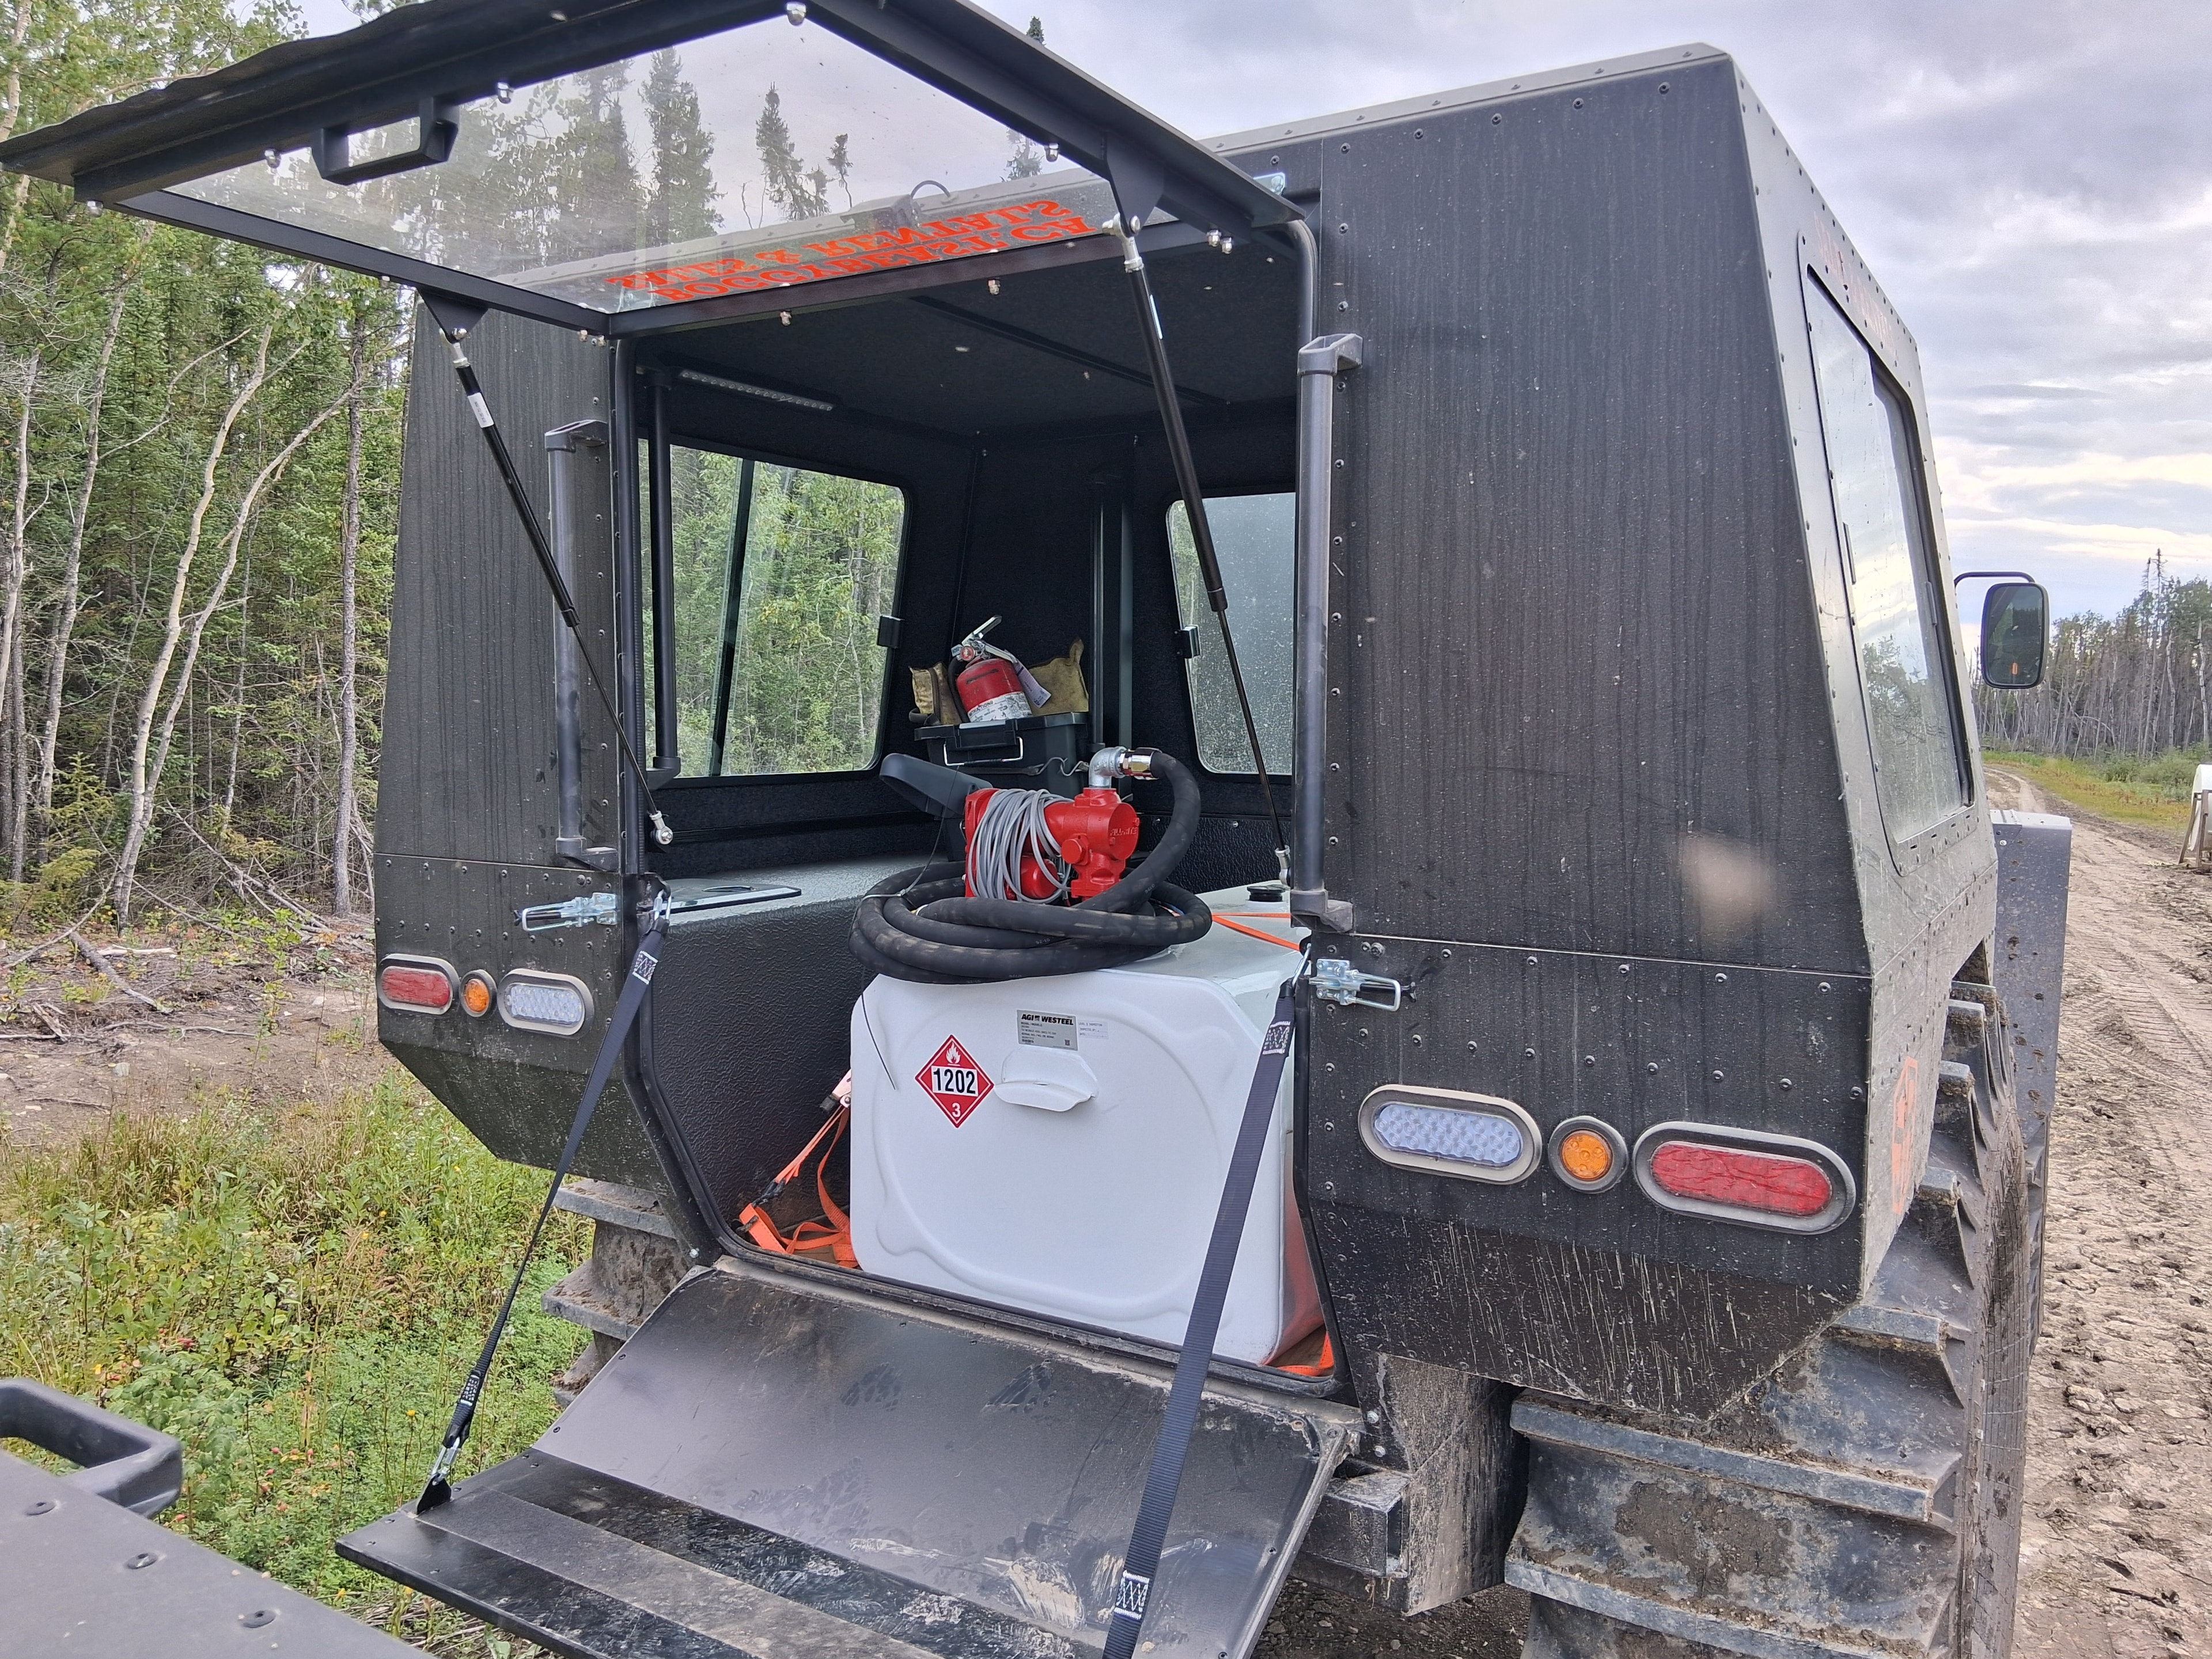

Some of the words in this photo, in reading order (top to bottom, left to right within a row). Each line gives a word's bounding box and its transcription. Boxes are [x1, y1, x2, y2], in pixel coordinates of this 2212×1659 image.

[1041, 1016, 1074, 1025] WESTEEL
[933, 1067, 976, 1094] 1202
[952, 1102, 961, 1118] 3
